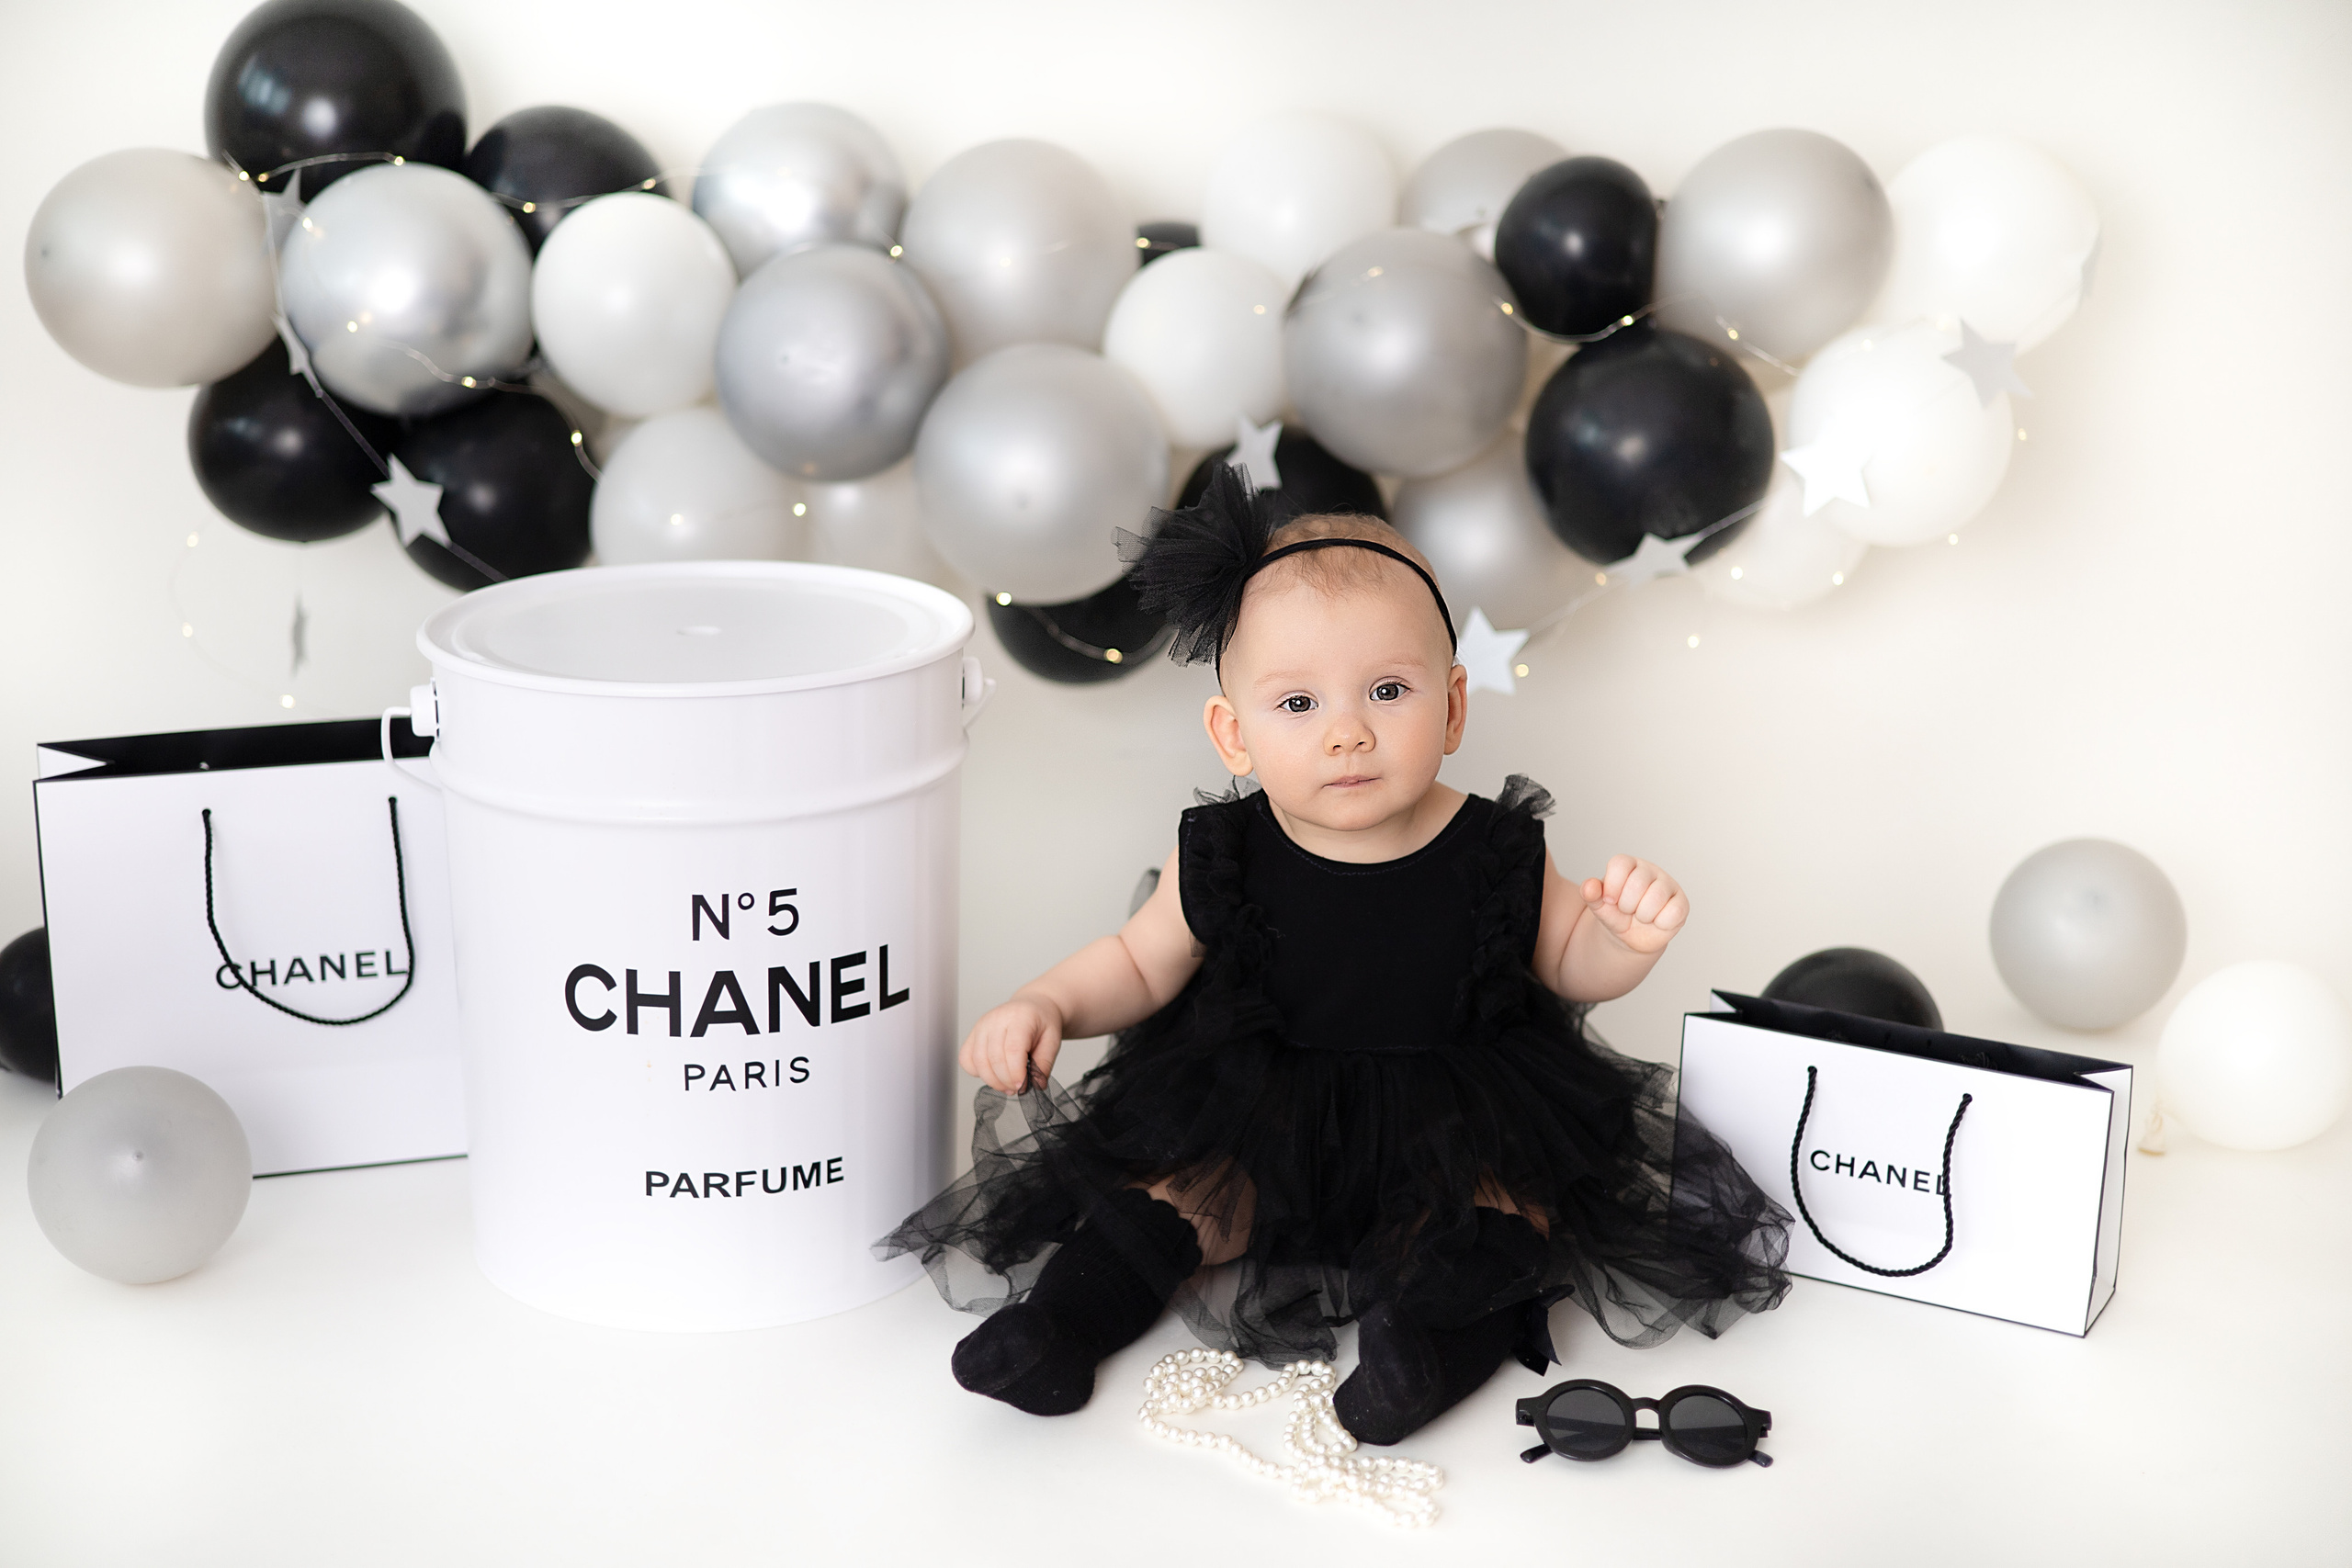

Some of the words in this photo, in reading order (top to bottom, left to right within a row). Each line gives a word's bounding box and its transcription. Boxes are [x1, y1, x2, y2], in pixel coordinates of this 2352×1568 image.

[215, 950, 409, 989] CHANEL
[564, 943, 910, 1038] CHANEL
[684, 1055, 810, 1091] PARIS
[645, 1156, 844, 1199] PARFUME
